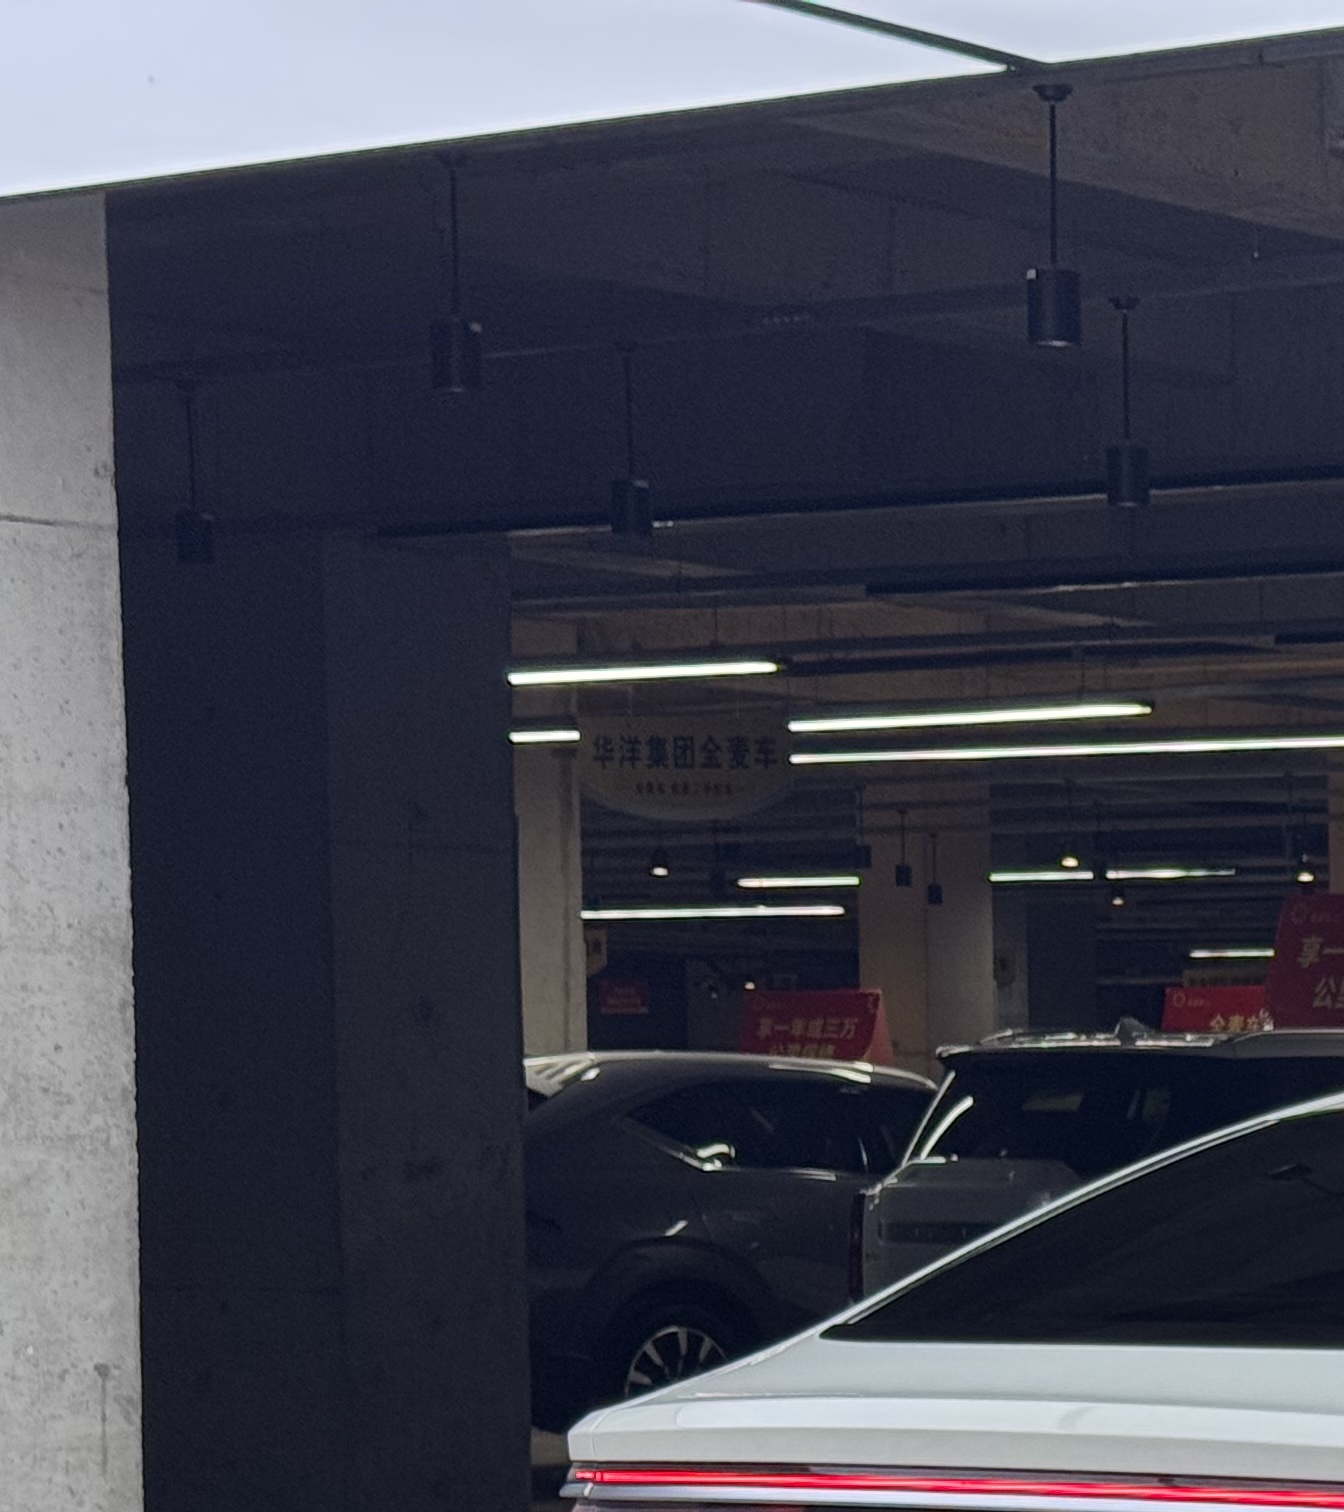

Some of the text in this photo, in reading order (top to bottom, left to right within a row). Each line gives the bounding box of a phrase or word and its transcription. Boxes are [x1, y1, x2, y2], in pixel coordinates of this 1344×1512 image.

[592, 734, 779, 770] 华洋集团全麦车
